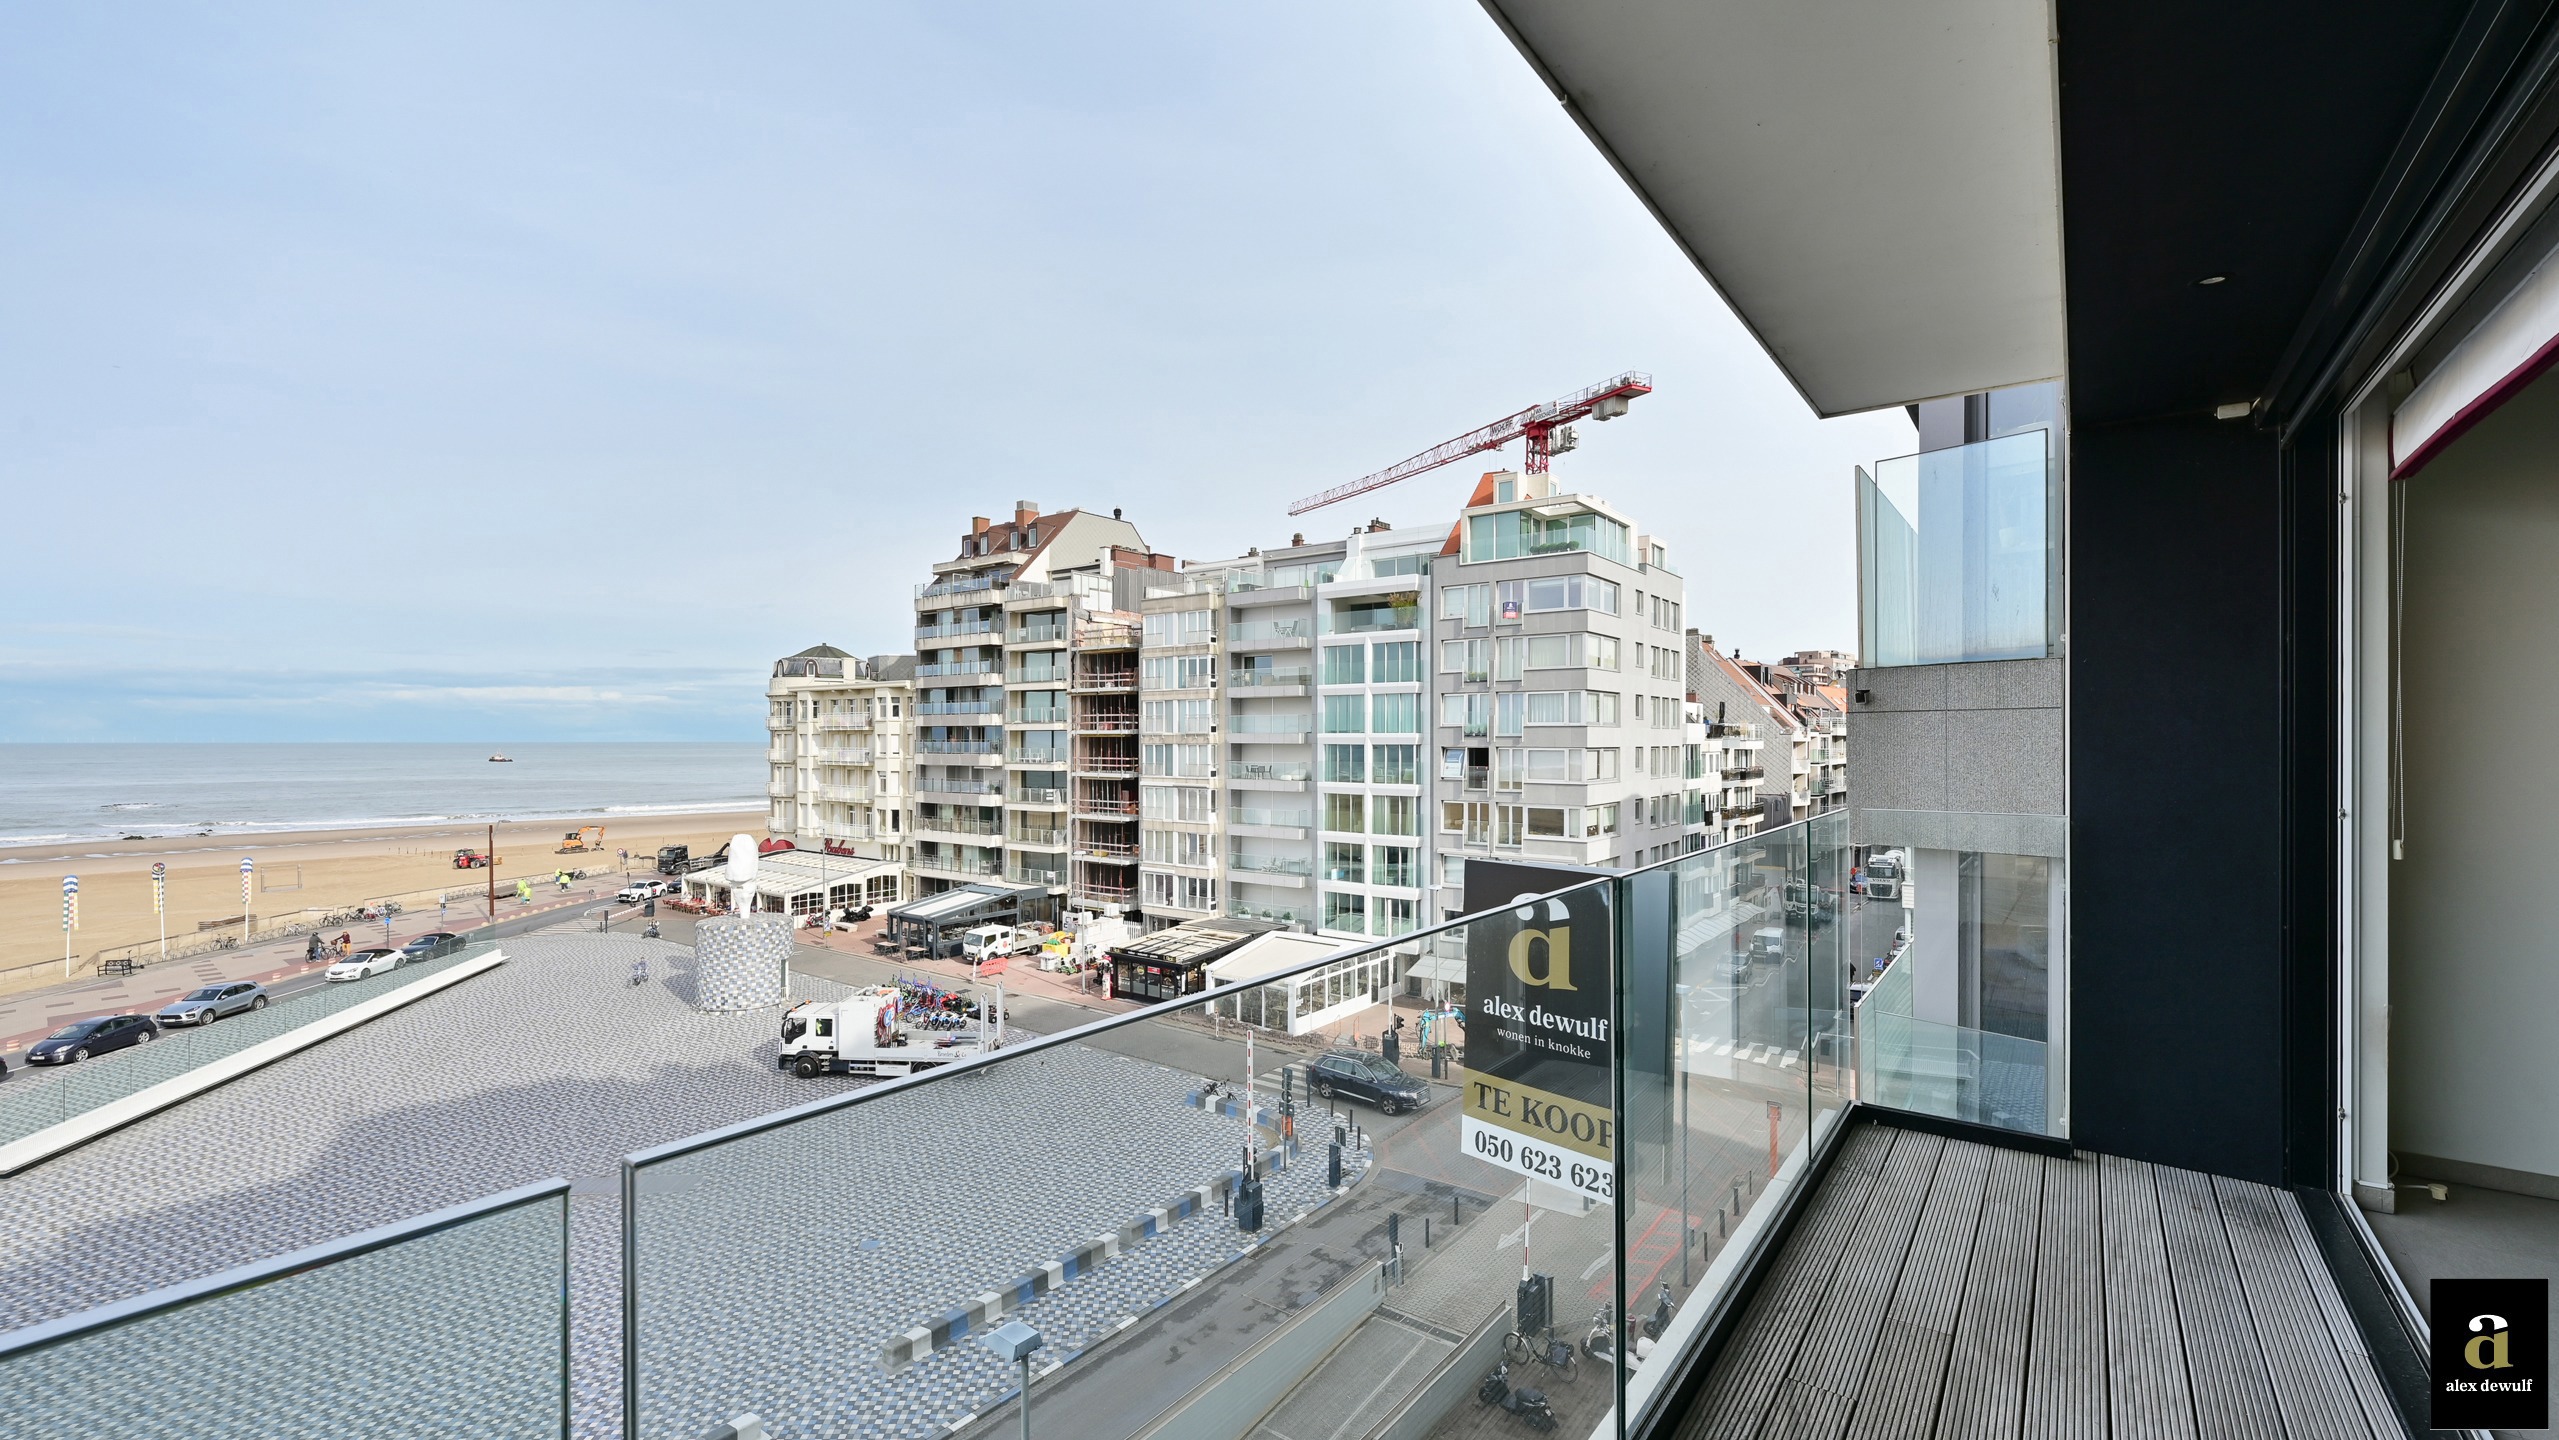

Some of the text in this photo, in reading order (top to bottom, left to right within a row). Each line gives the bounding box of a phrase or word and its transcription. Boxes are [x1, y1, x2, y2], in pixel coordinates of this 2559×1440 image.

[1483, 995, 1608, 1042] alex dewulf
[1496, 1027, 1591, 1059] wonen in knokke
[1473, 1081, 1511, 1118] TE
[1475, 1130, 1612, 1198] 050 623 623
